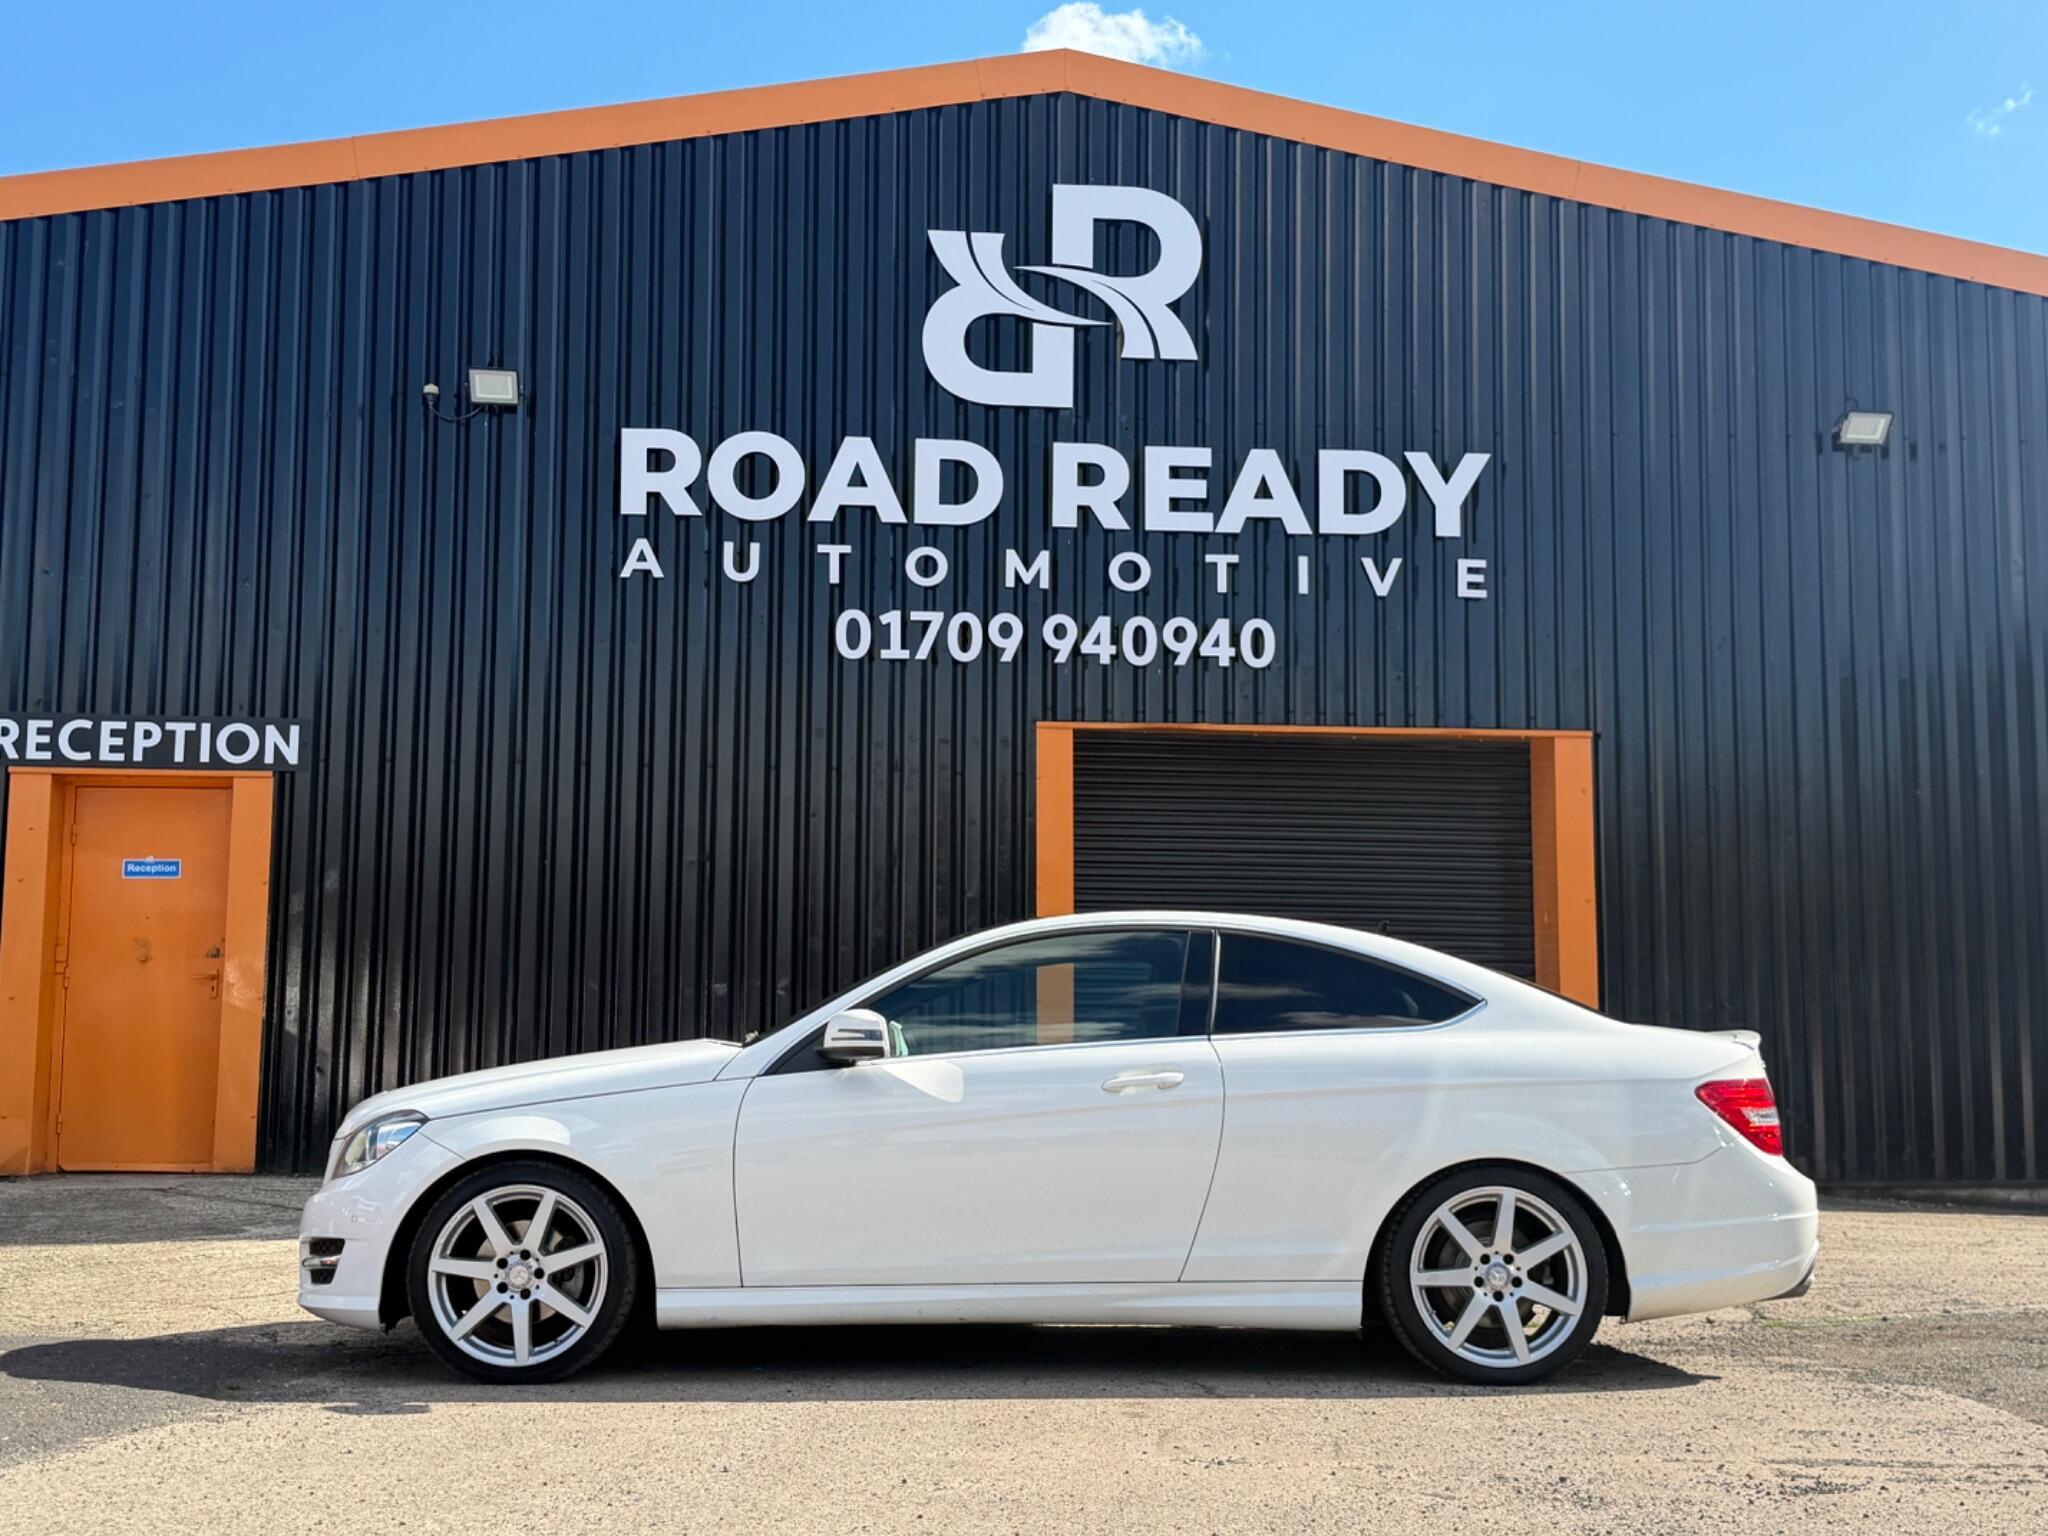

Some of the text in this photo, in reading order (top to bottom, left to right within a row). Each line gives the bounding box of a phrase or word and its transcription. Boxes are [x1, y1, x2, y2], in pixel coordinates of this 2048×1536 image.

[620, 428, 1491, 538] ROAD READY
[620, 538, 1489, 599] AUTOMOTIVE
[835, 609, 1276, 669] 01709 940940
[0, 718, 300, 765] RECEPTION
[127, 863, 177, 874] Reception
